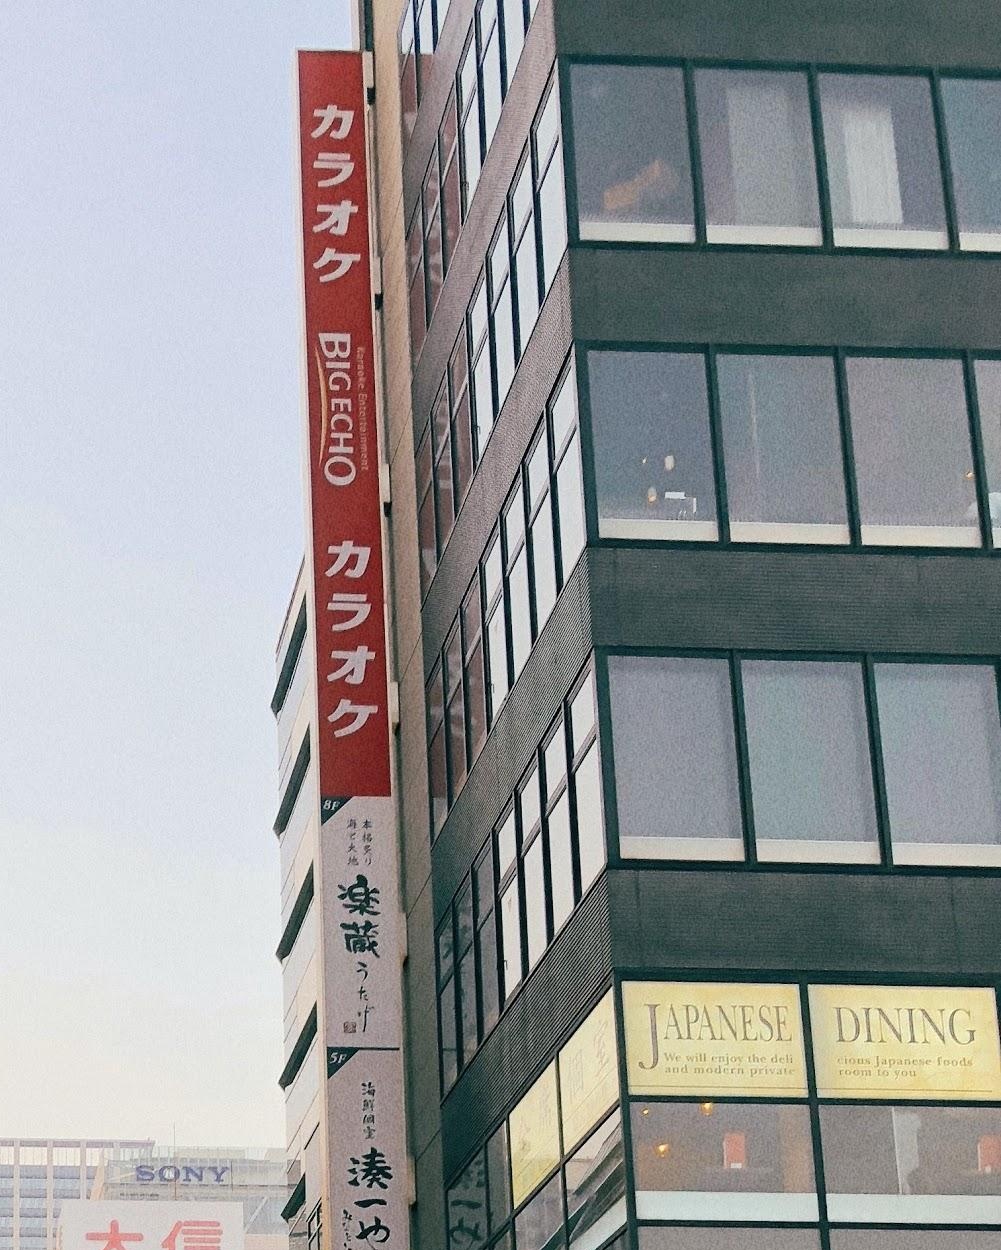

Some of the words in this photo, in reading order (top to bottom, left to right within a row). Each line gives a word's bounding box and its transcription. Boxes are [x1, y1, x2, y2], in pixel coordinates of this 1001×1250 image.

[310, 104, 361, 284] カラオケ
[318, 332, 352, 391] BIG
[355, 346, 366, 390] Karaoke
[323, 398, 357, 487] ECHO
[324, 540, 379, 738] カラオケ
[638, 1003, 793, 1070] JAPANESE
[833, 1006, 977, 1046] DINING
[663, 1052, 681, 1063] We
[686, 1052, 708, 1063] will
[747, 1053, 767, 1064] the
[770, 1054, 794, 1065] deli
[875, 1055, 932, 1071] Japanese
[693, 1065, 745, 1076] modern
[749, 1066, 796, 1079] private
[838, 1068, 873, 1078] room
[876, 1067, 890, 1078] to
[893, 1068, 918, 1081] you
[135, 1164, 230, 1183] SONY
